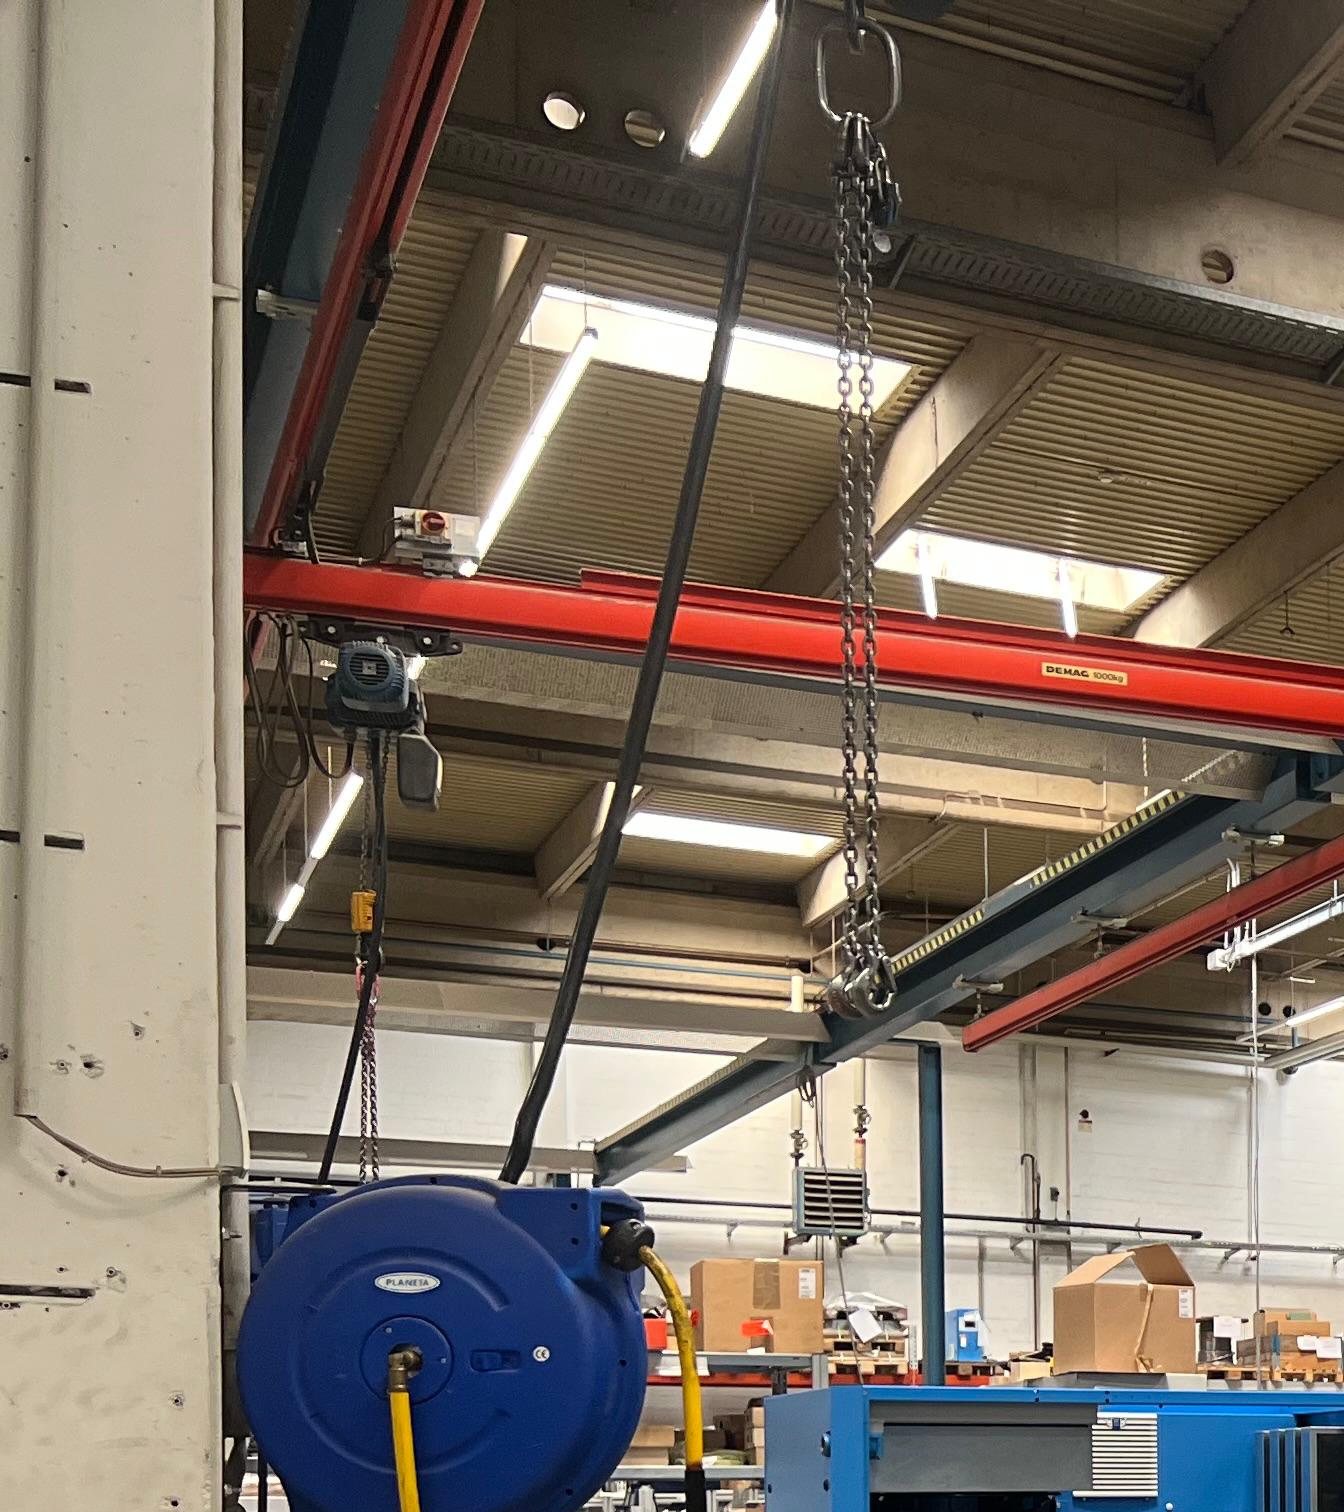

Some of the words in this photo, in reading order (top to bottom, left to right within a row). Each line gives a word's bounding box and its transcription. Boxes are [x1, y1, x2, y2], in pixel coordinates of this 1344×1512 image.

[1046, 665, 1090, 678] DEMAG
[1093, 671, 1124, 683] 1000kg
[385, 1278, 430, 1288] PLANETA
